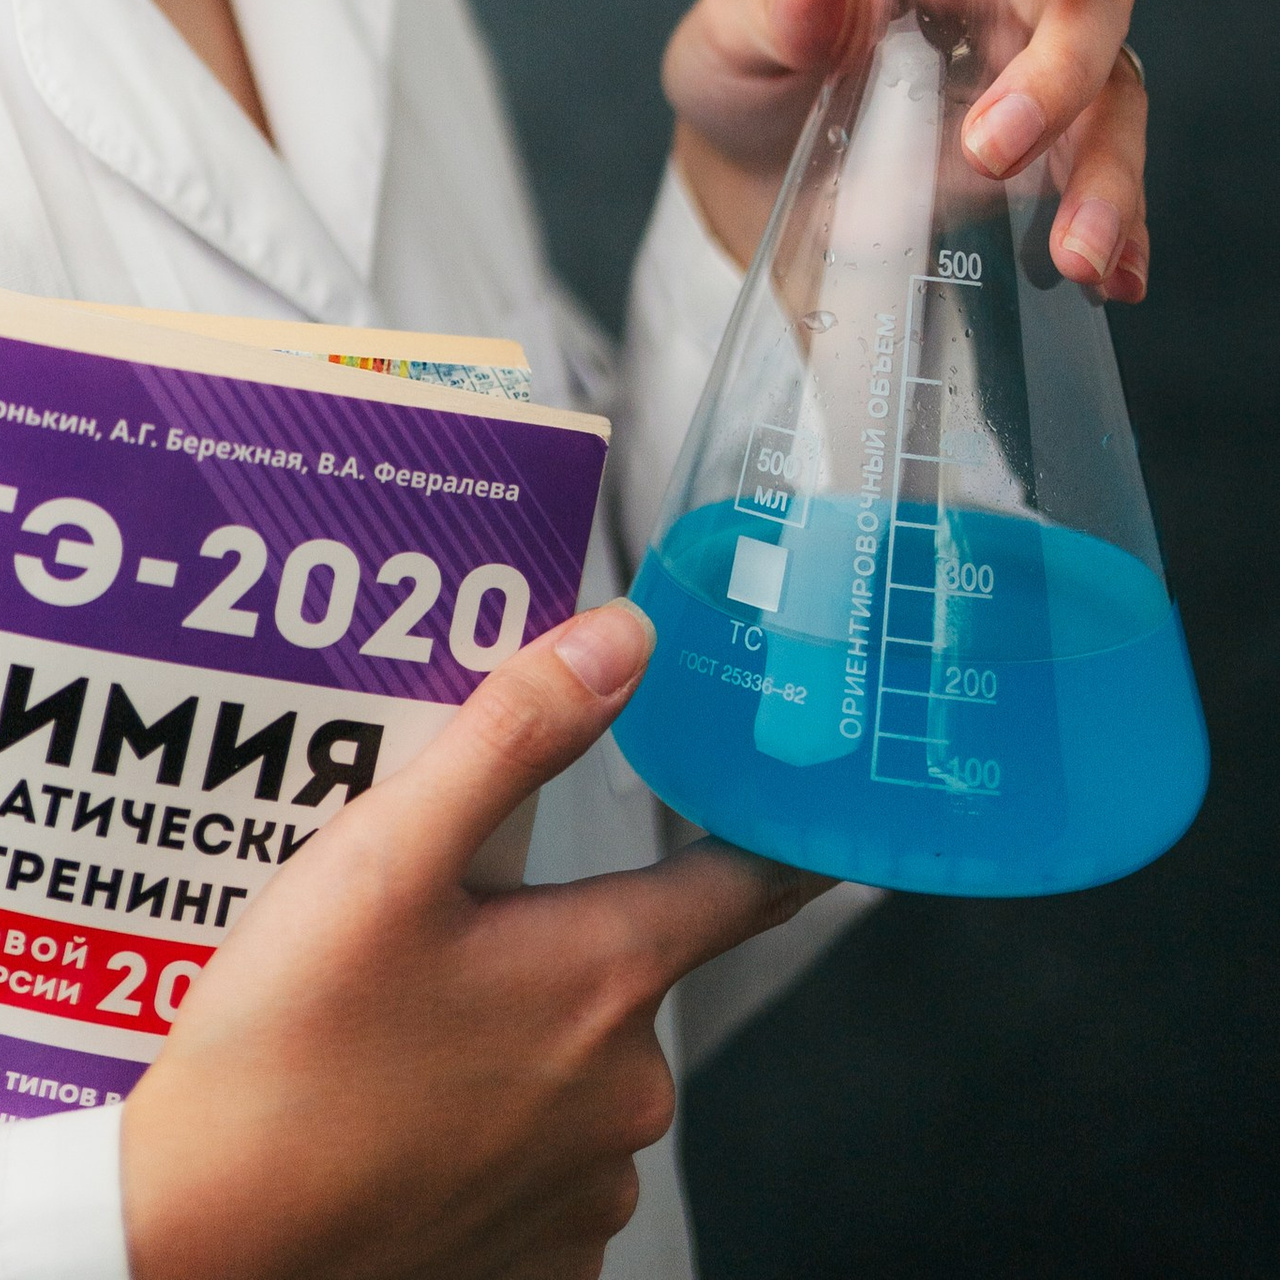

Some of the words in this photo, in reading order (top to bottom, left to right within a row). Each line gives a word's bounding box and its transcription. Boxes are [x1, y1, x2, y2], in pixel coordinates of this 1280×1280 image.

[937, 250, 982, 280] 500
[109, 418, 157, 448] А.Г.
[166, 427, 308, 475] Бережная,
[318, 452, 365, 481] В.А.
[373, 462, 520, 502] Февралева
[757, 448, 798, 480] 500
[839, 427, 886, 740] ОРИЕНТИРОВОЧНЫЙ
[867, 313, 897, 419] ОБЪЕМ
[944, 560, 994, 593] 300
[730, 620, 763, 651] ТС
[679, 649, 719, 677] ГОСТ
[945, 666, 997, 699] 200
[947, 756, 1000, 789] 100
[5, 1070, 98, 1107] ТИПОВ
